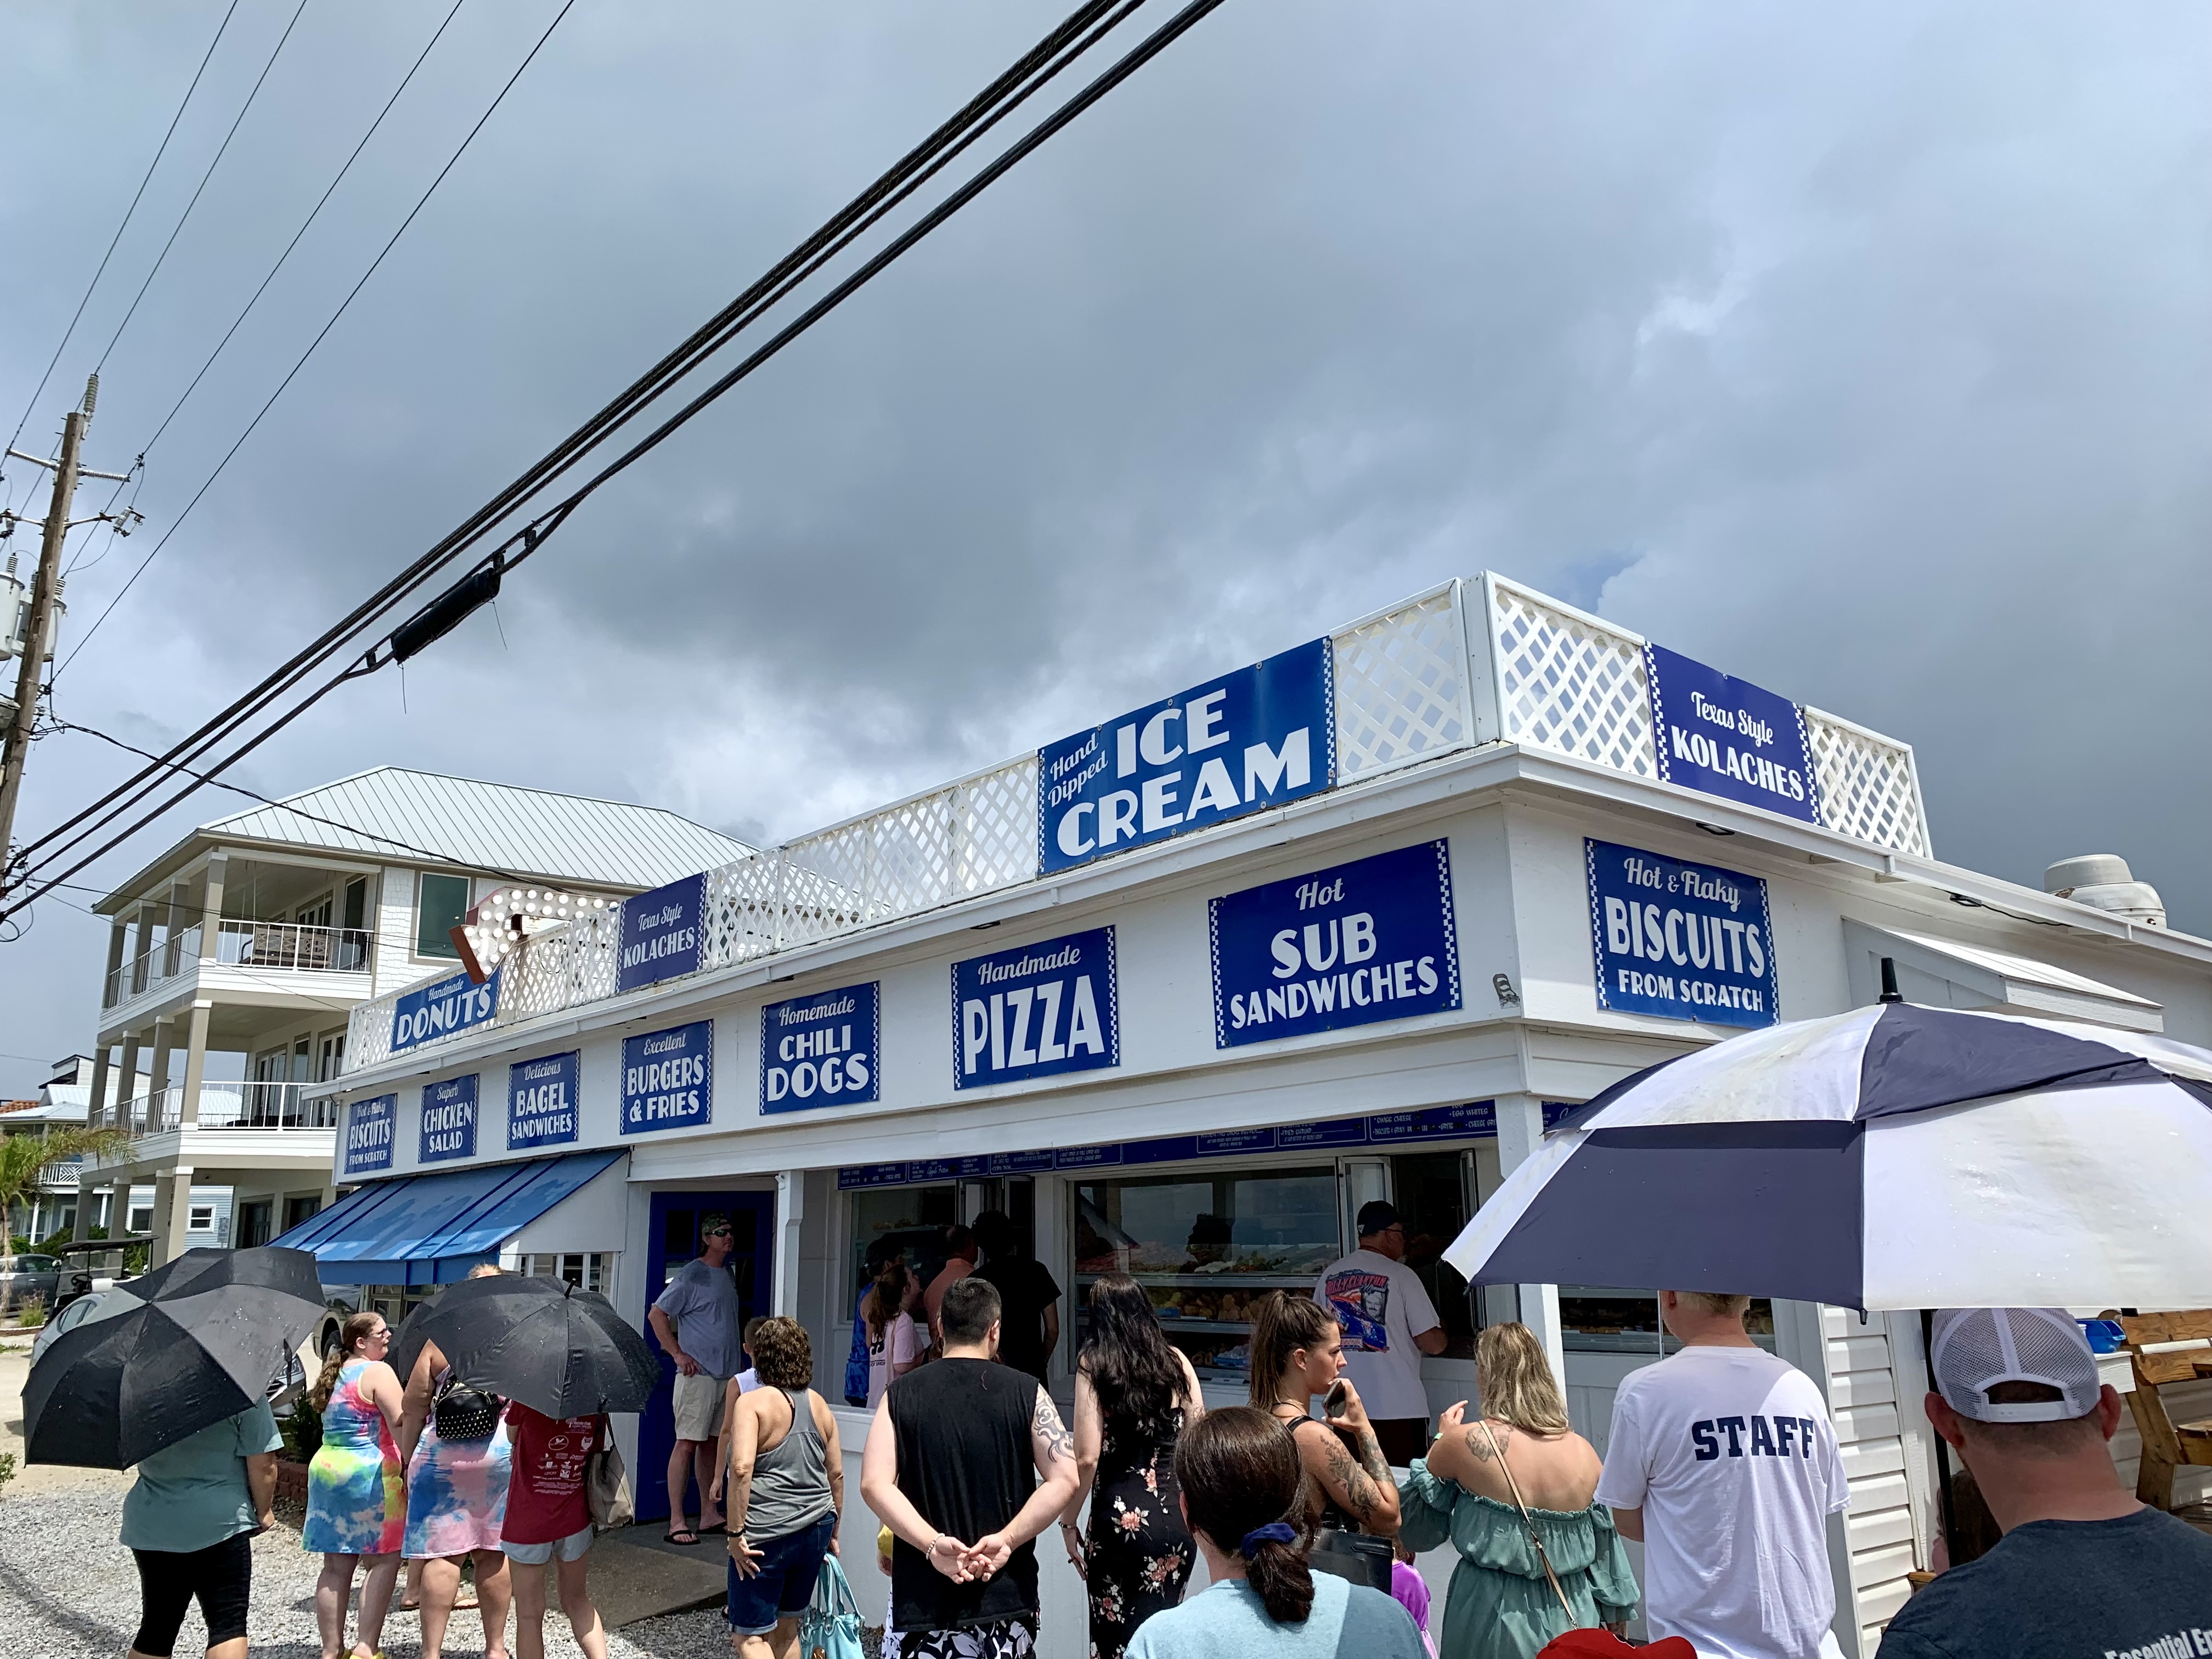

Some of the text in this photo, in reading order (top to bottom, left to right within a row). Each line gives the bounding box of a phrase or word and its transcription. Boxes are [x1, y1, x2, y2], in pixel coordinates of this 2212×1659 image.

[1118, 689, 1229, 778] ICE
[1691, 692, 1773, 747] Texas Style
[1050, 733, 1098, 782] Hand
[1672, 726, 1804, 801] KOLACHES
[1048, 751, 1108, 807] Dipped
[1057, 727, 1311, 856] CREAM
[1296, 878, 1345, 910] Hot
[1624, 858, 1741, 912] Hot & Flaky
[638, 903, 682, 932] Texas Style
[624, 927, 694, 968] KOLACHES
[1271, 912, 1376, 978] SUB
[1605, 896, 1764, 978] BISCUITS
[978, 945, 1081, 985] Handmade
[428, 979, 464, 1001] Handmade
[1231, 956, 1438, 1029] SANDWICHES
[1618, 969, 1763, 1012] FROM SCRATCH
[397, 983, 491, 1045] DONUTS
[780, 996, 855, 1026] Homemade
[963, 975, 1104, 1074] PIZZA
[644, 1033, 686, 1056] Excellent
[780, 1025, 850, 1061] CHILI
[524, 1063, 561, 1080] Delicious
[627, 1054, 703, 1096] BURGERS
[768, 1053, 868, 1101] DOGS
[437, 1084, 458, 1102] Superb
[516, 1082, 568, 1116] BAGEL
[630, 1090, 699, 1122] & FRIES
[1466, 1108, 1488, 1116] WHITES
[349, 1118, 390, 1150] BISCUITS
[424, 1101, 472, 1133] CHICKEN
[512, 1113, 572, 1140] SANDWICHES
[1394, 1114, 1412, 1122] CHEESE
[1469, 1120, 1486, 1128] CHEESE
[349, 1150, 387, 1165] FROM SCRATCH
[429, 1131, 462, 1153] SALAD
[1692, 1415, 1814, 1461] STAFF
